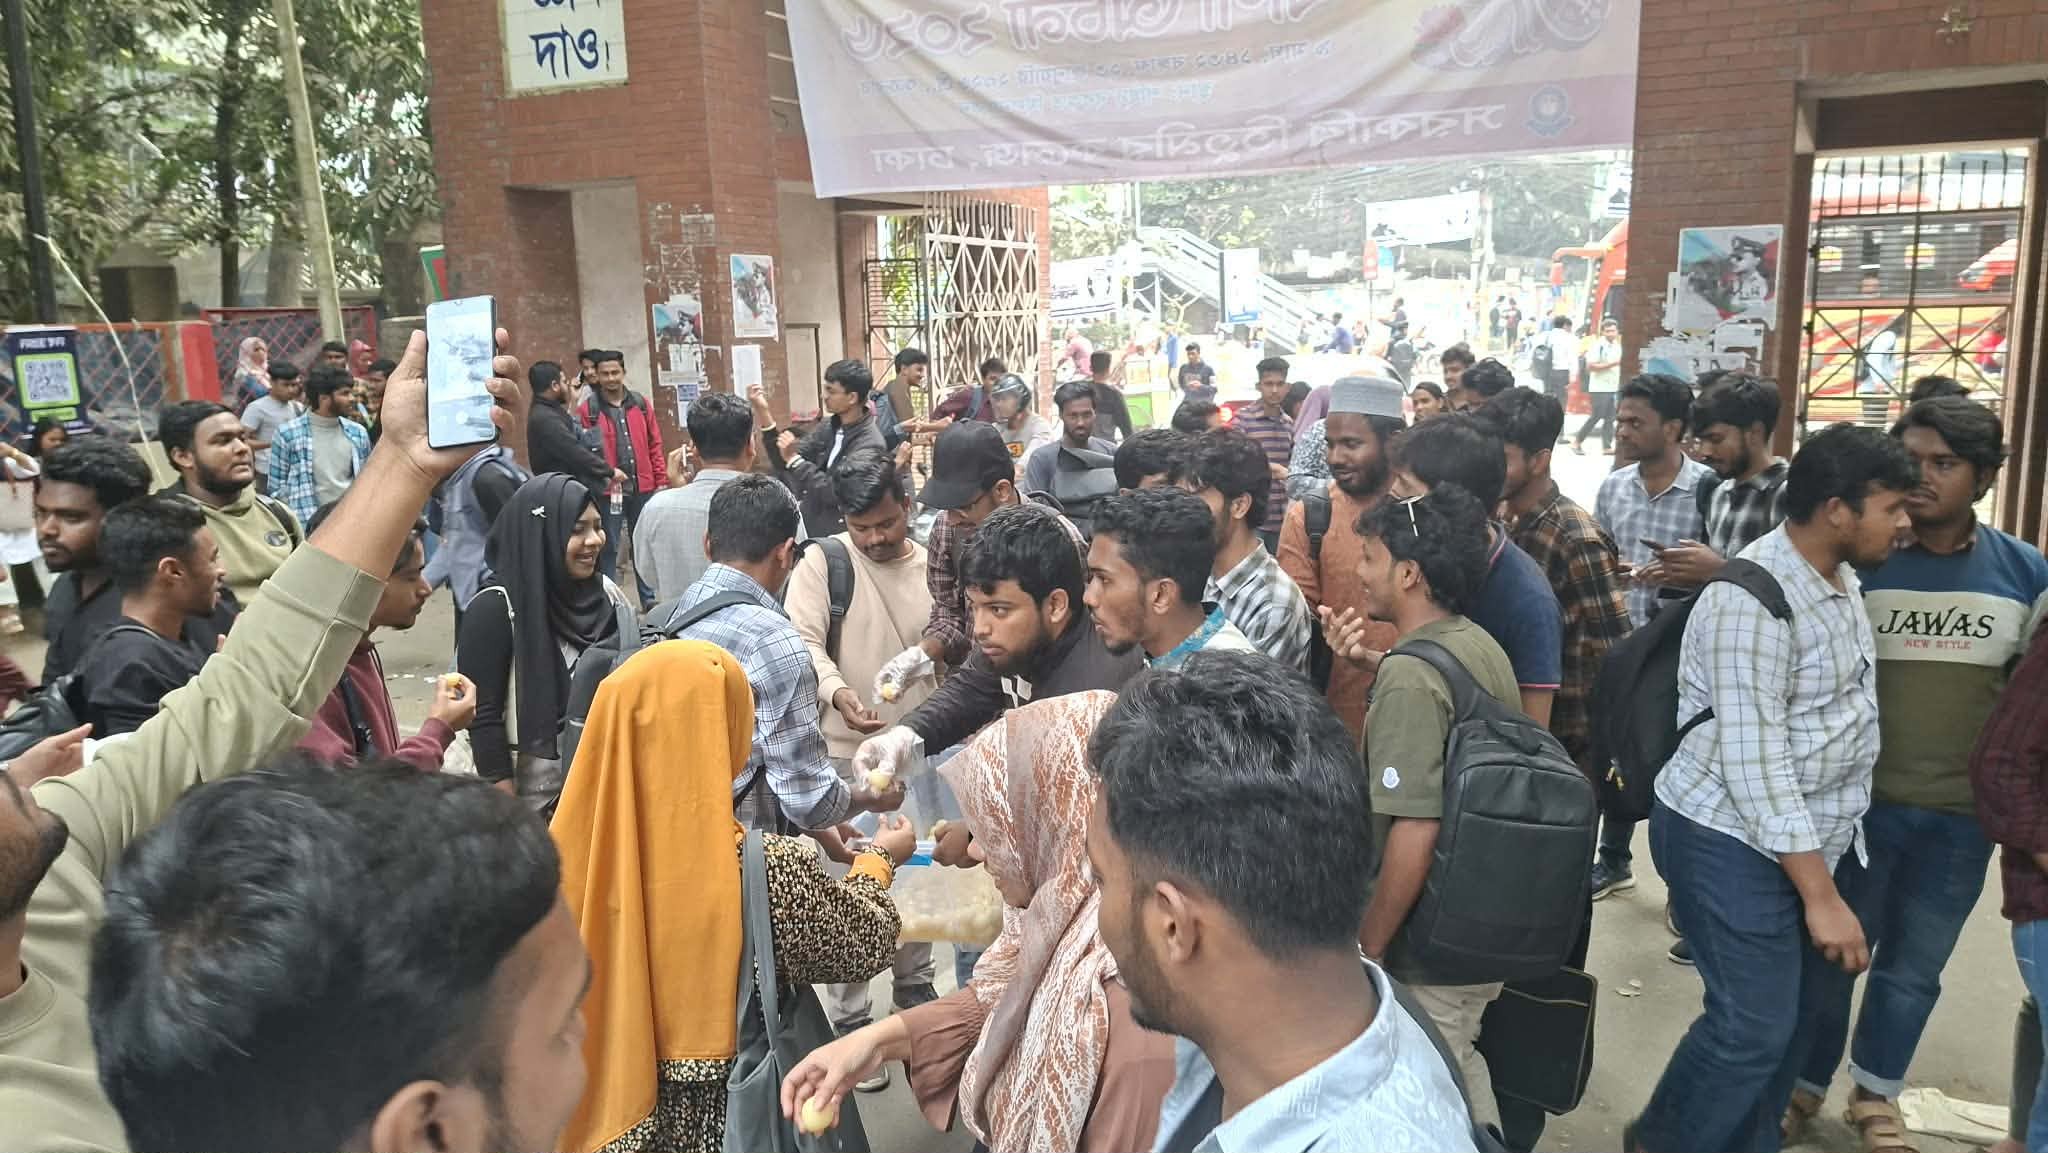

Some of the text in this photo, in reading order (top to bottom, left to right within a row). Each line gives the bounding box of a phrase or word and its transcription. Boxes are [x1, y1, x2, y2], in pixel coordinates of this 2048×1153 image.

[1877, 605, 1996, 639] JAWAS
[1904, 639, 1972, 650] NEW STYLE
